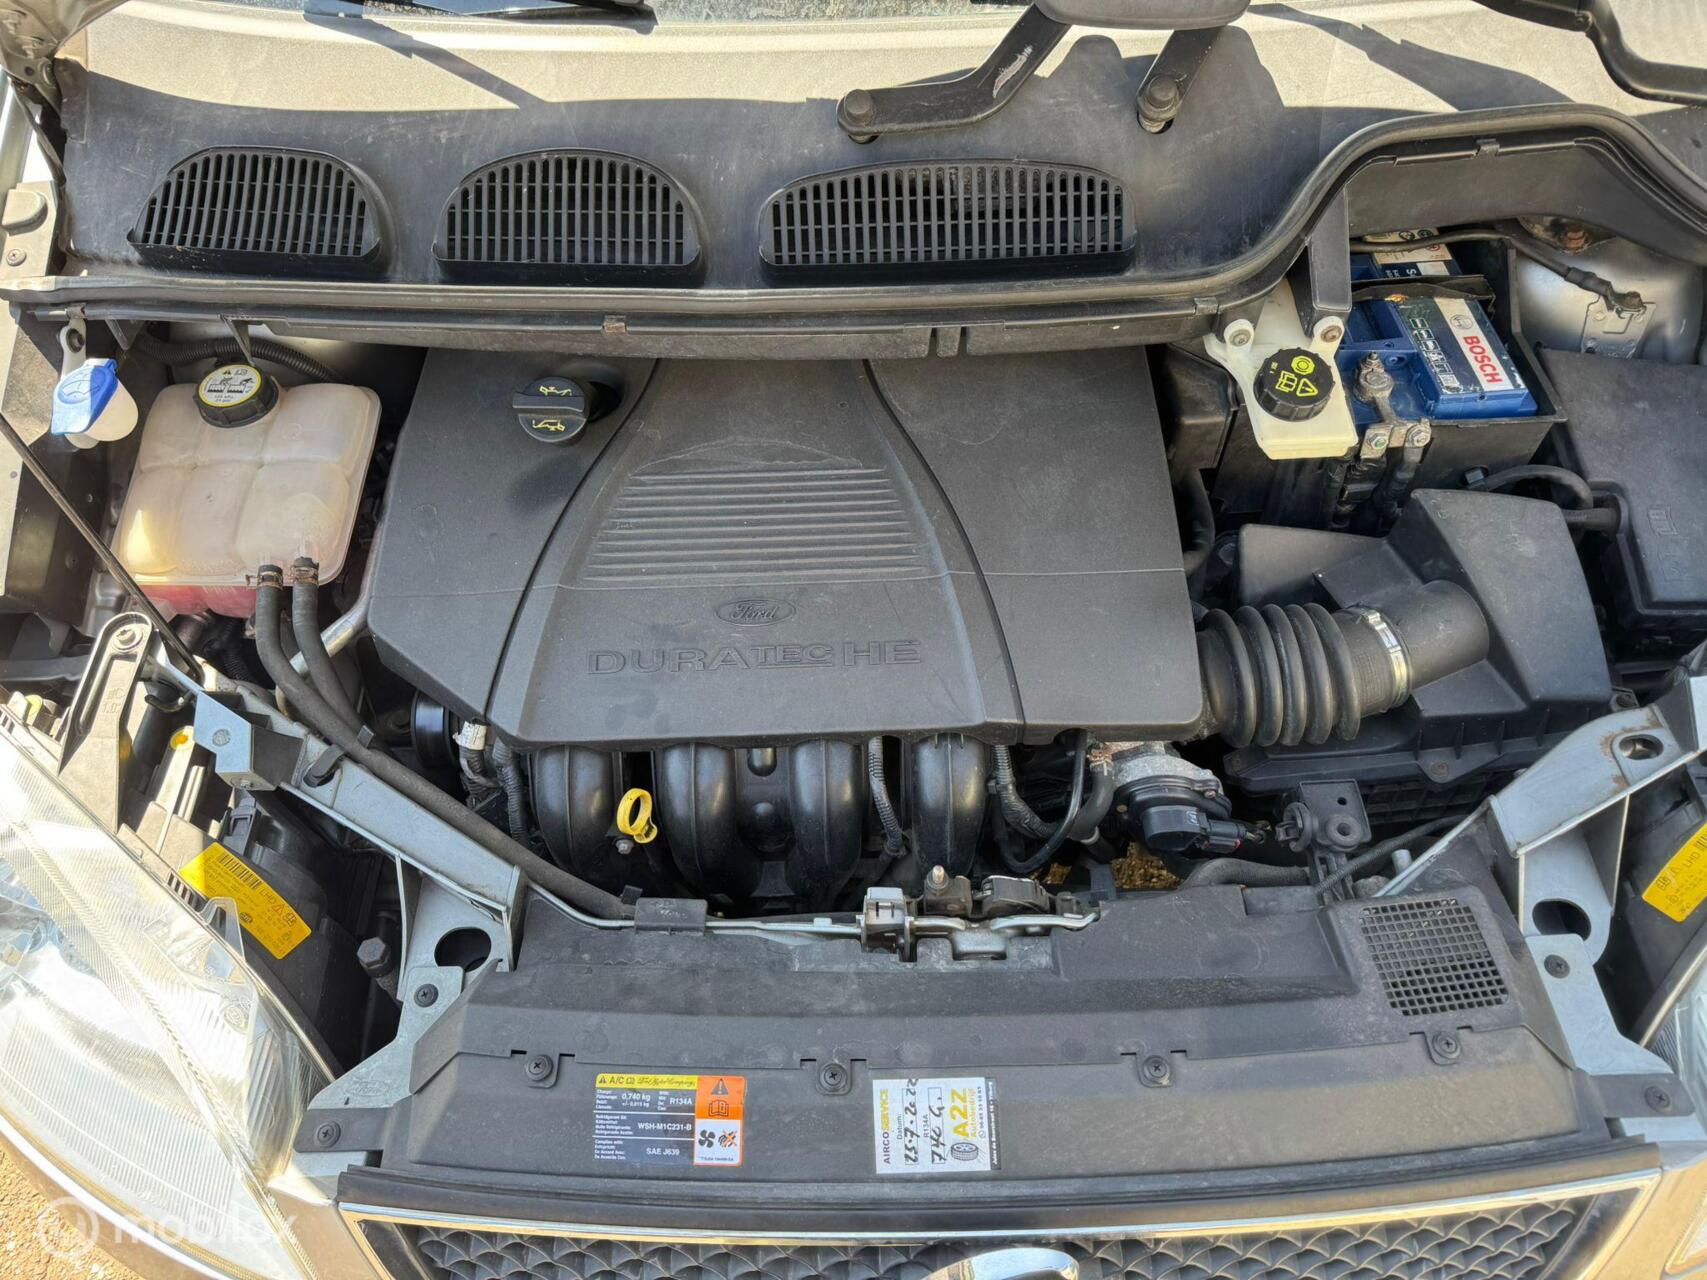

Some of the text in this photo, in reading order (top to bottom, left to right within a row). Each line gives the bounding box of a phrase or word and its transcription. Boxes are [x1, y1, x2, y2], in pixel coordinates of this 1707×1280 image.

[1463, 334, 1504, 383] BOSCH
[731, 601, 777, 621] Ford
[842, 639, 922, 667] HE
[609, 1075, 624, 1084] A/C
[641, 1093, 651, 1102] kg
[669, 1097, 693, 1105] R134A
[949, 1087, 969, 1138] A2Z
[645, 1147, 662, 1156] SAE
